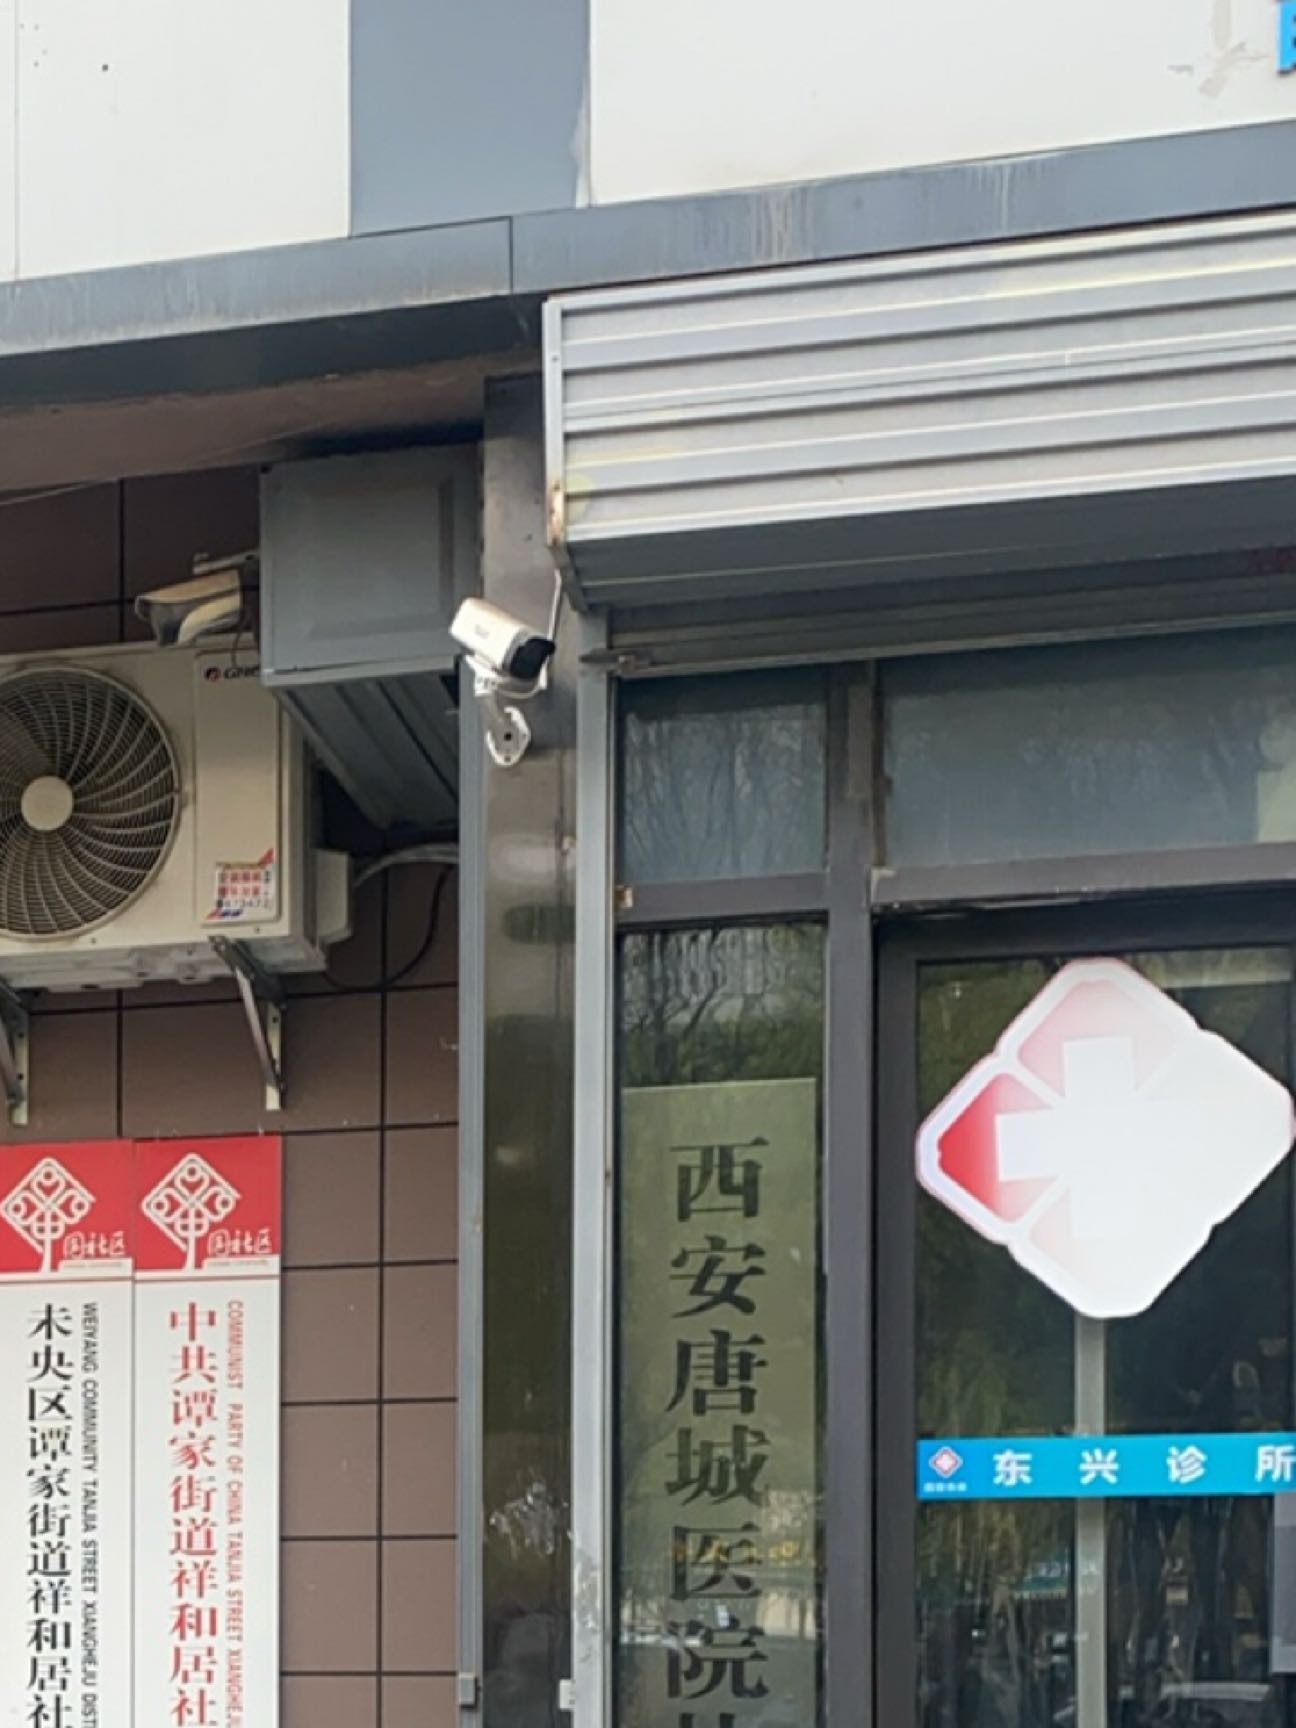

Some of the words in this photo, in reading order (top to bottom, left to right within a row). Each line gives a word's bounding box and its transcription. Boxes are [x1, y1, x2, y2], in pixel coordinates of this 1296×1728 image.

[81, 1302, 99, 1373] WEIYANG
[226, 1300, 244, 1389] COMMUNIST
[81, 1379, 99, 1471] COMMUNITY
[226, 1403, 244, 1448] PARTY
[226, 1455, 244, 1474] OF
[993, 1444, 1296, 1486] 东兴诊所
[81, 1479, 99, 1532] TANJIA
[226, 1480, 244, 1525] CHINA
[81, 1539, 99, 1593] STREET
[226, 1532, 244, 1583] TANJIA
[226, 1589, 244, 1642] STREET
[81, 1599, 99, 1686] XIANGHEJU
